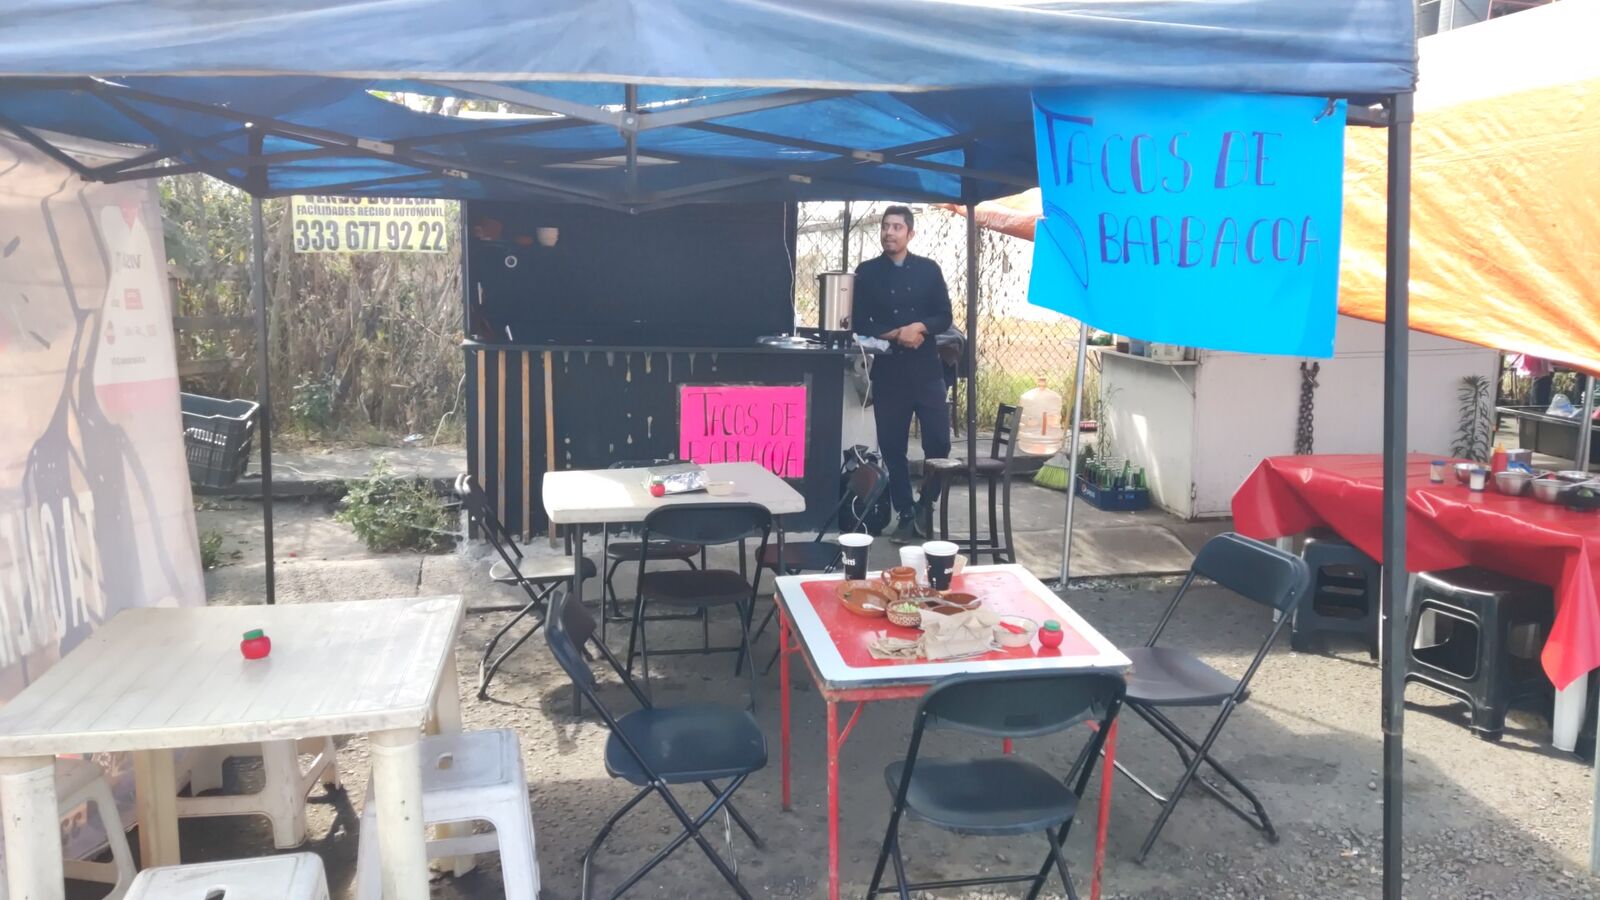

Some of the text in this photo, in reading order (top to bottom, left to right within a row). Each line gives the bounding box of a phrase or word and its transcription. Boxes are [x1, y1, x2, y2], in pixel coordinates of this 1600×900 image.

[1031, 99, 1283, 194] TACOS DE
[297, 204, 355, 216] FACILIDADES
[358, 207, 391, 217] RECIBO
[296, 219, 444, 250] 333 677 92 22
[1098, 211, 1321, 269] BARBACOA
[687, 392, 799, 437] TACOS DE
